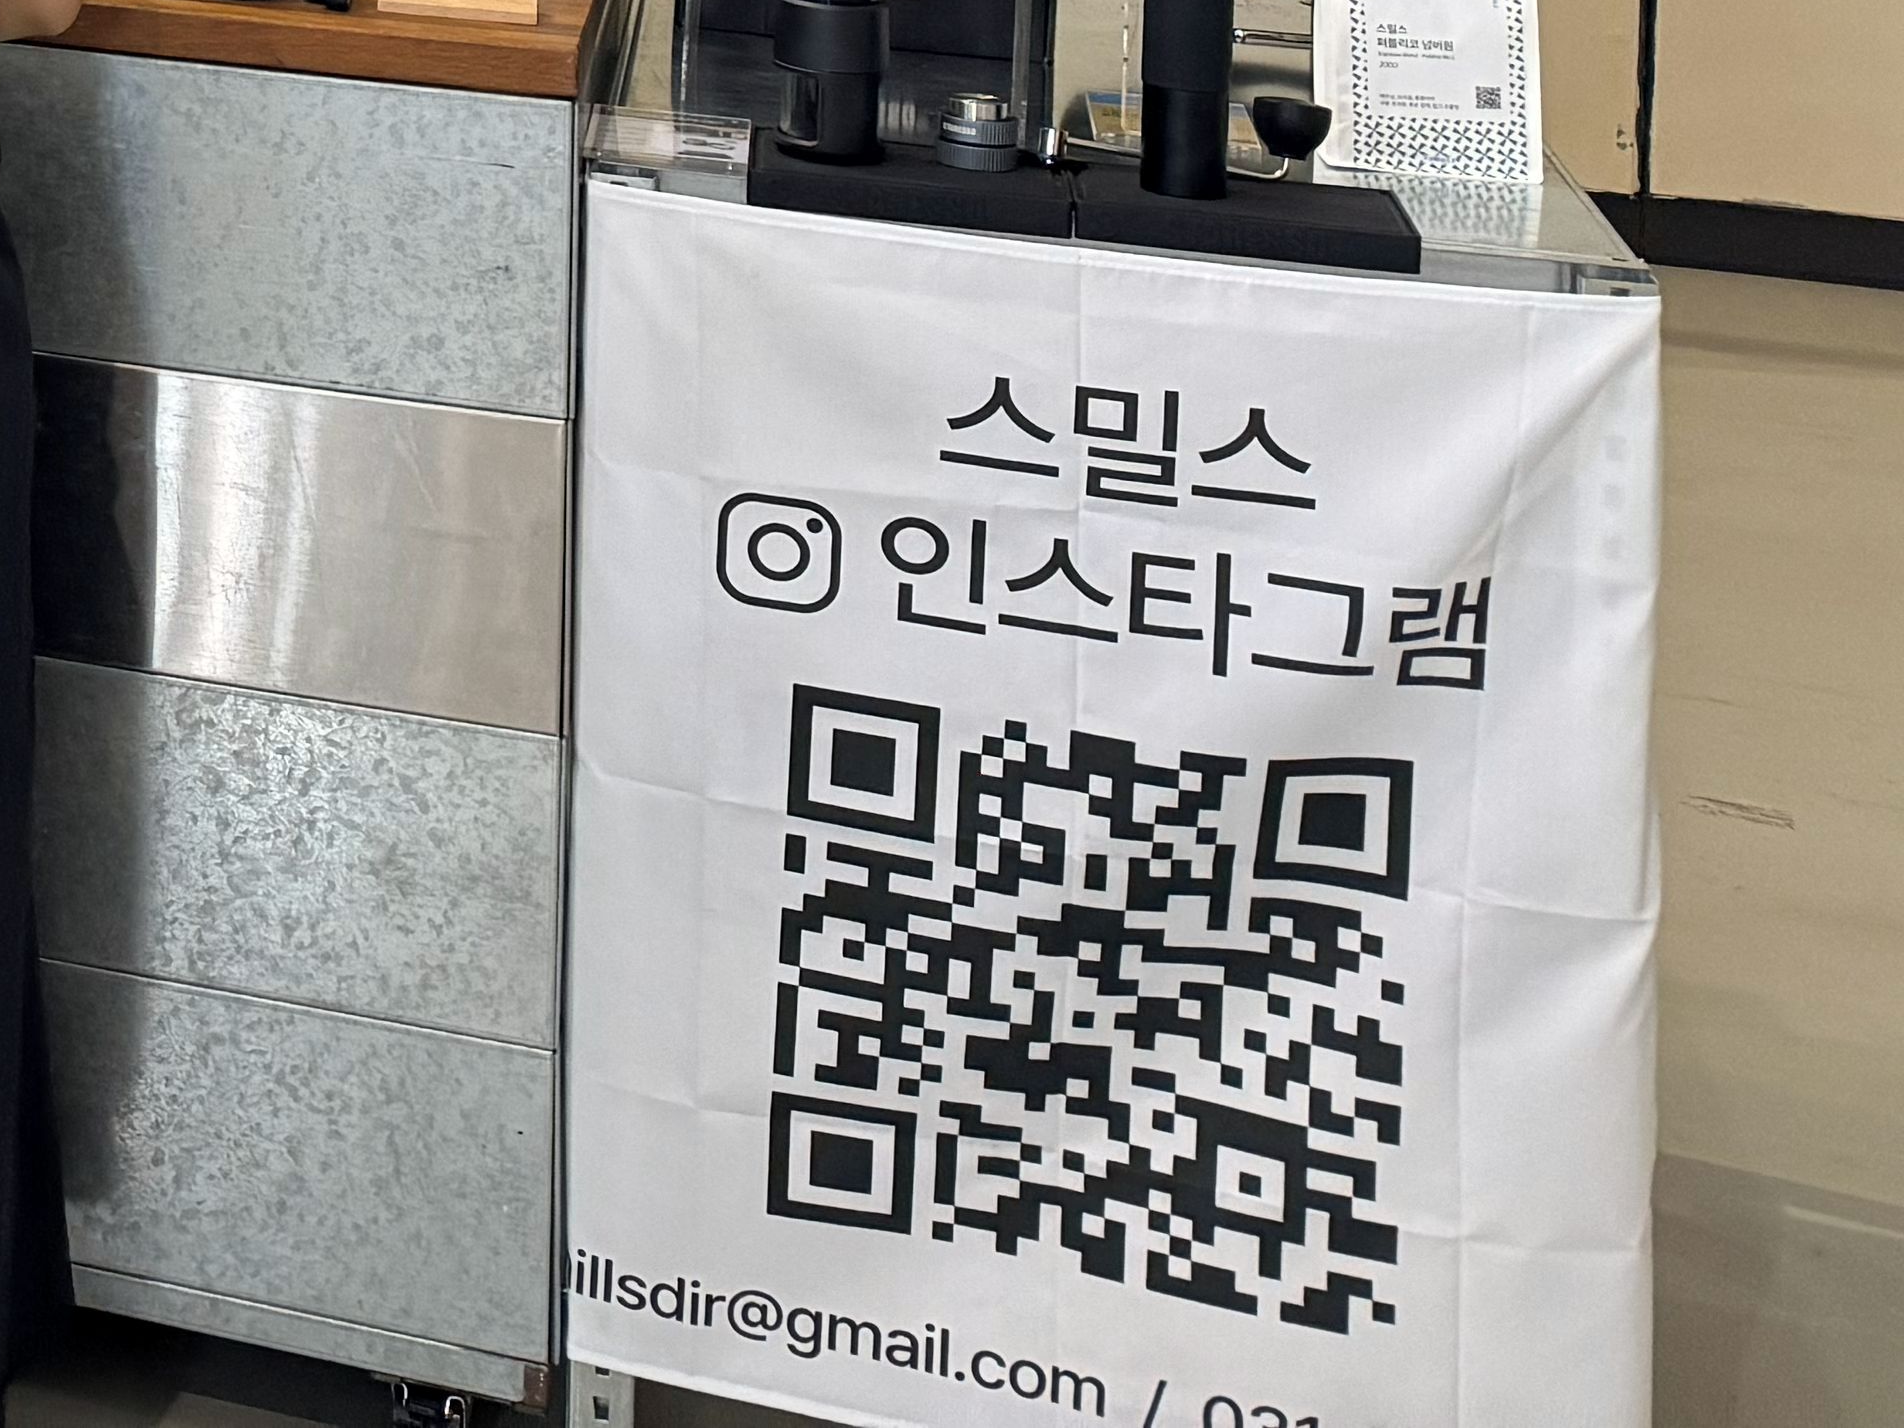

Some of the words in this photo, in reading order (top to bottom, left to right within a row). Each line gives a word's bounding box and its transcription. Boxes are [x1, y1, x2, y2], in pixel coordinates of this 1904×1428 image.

[939, 376, 1317, 510] 스밀스
[880, 515, 1493, 692] 인스타그램
[563, 1247, 1107, 1418] illsdir@gmail.com
